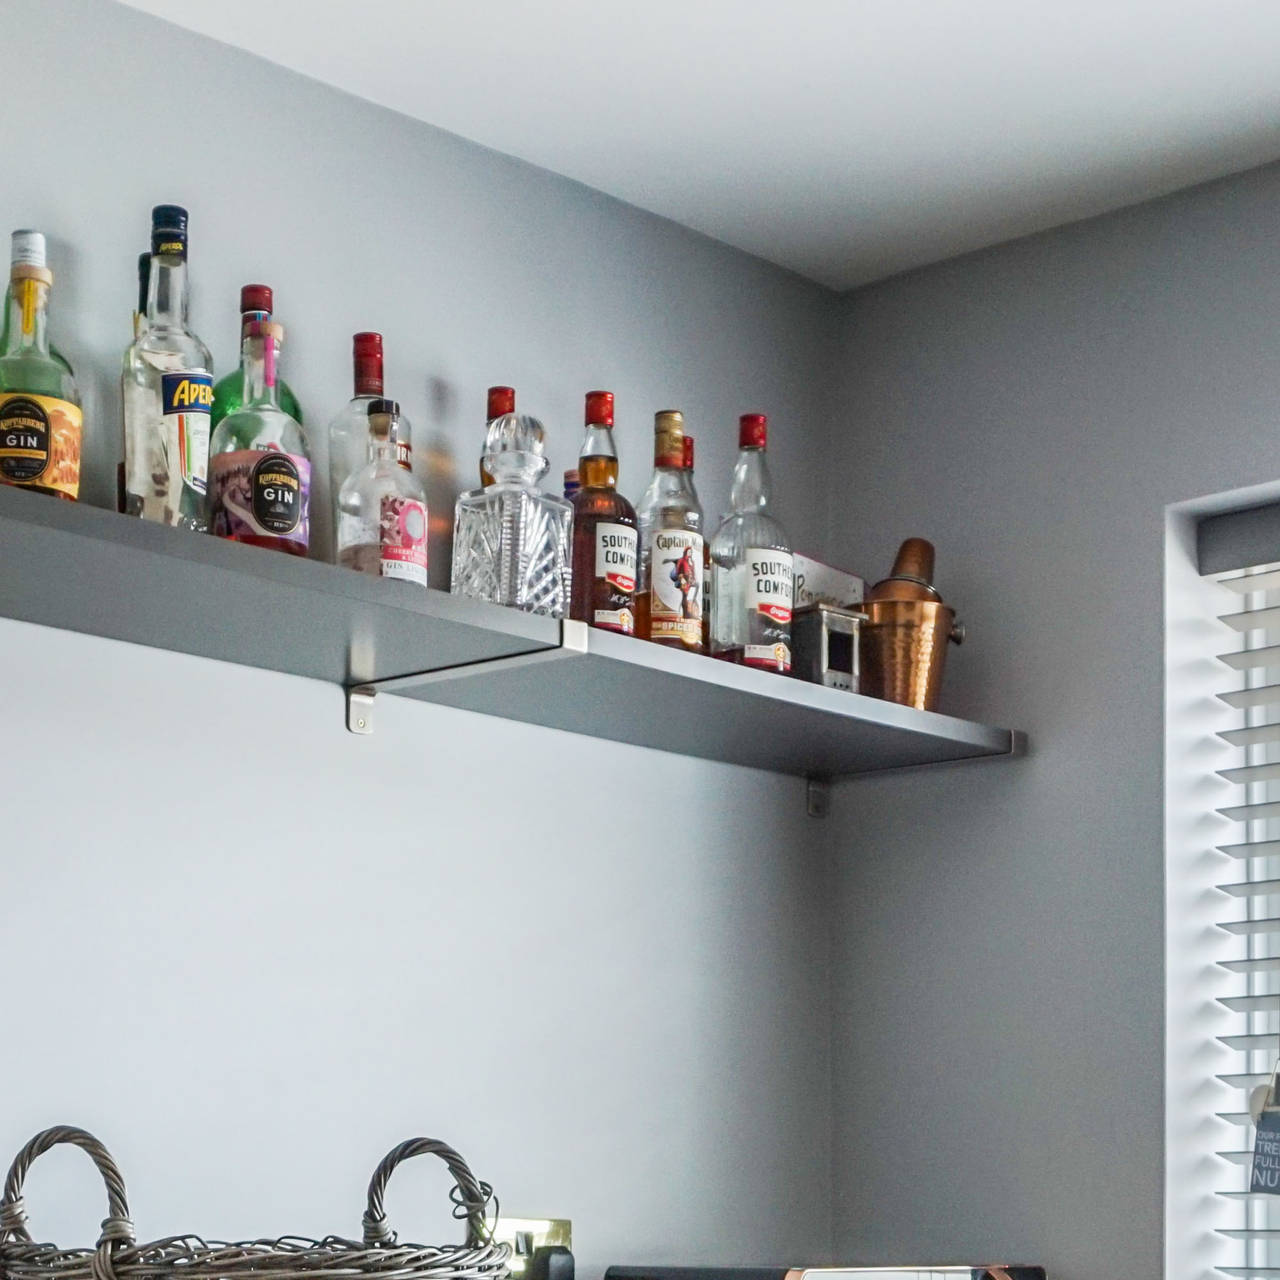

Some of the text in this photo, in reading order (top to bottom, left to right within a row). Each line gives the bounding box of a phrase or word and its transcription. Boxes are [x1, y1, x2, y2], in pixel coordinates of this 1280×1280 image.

[6, 435, 38, 448] GIN
[263, 488, 293, 504] GIN
[1255, 1155, 1280, 1169] FULL
